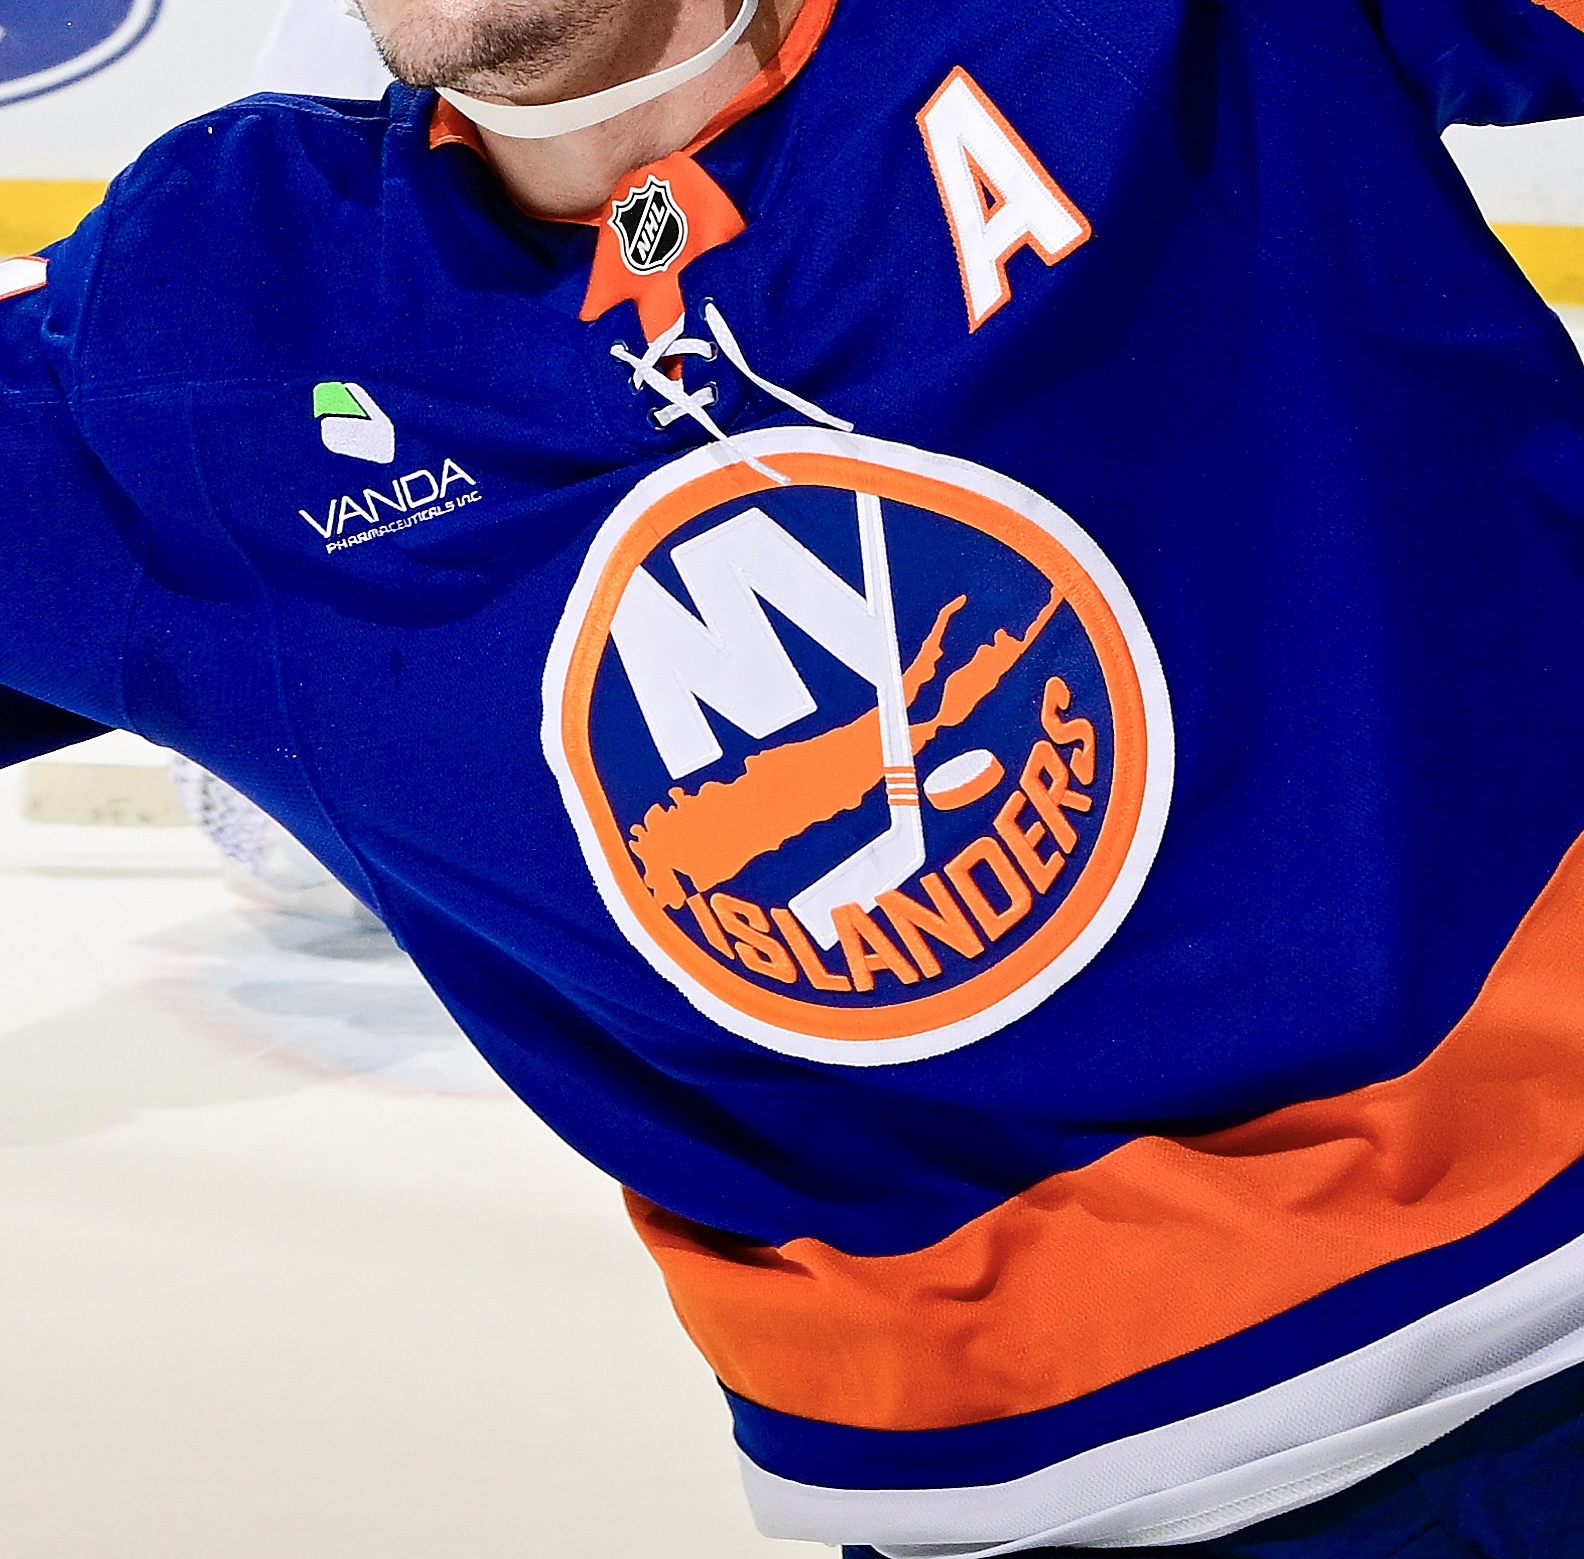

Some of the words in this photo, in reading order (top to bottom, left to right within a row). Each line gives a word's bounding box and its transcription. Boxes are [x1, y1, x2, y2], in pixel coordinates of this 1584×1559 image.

[636, 201, 667, 262] NHL
[916, 65, 1092, 334] A
[298, 458, 477, 539] VANDA
[325, 499, 456, 554] PHARMACEUTICALS
[610, 496, 919, 807] NY
[688, 675, 1096, 993] ISLANDERS
